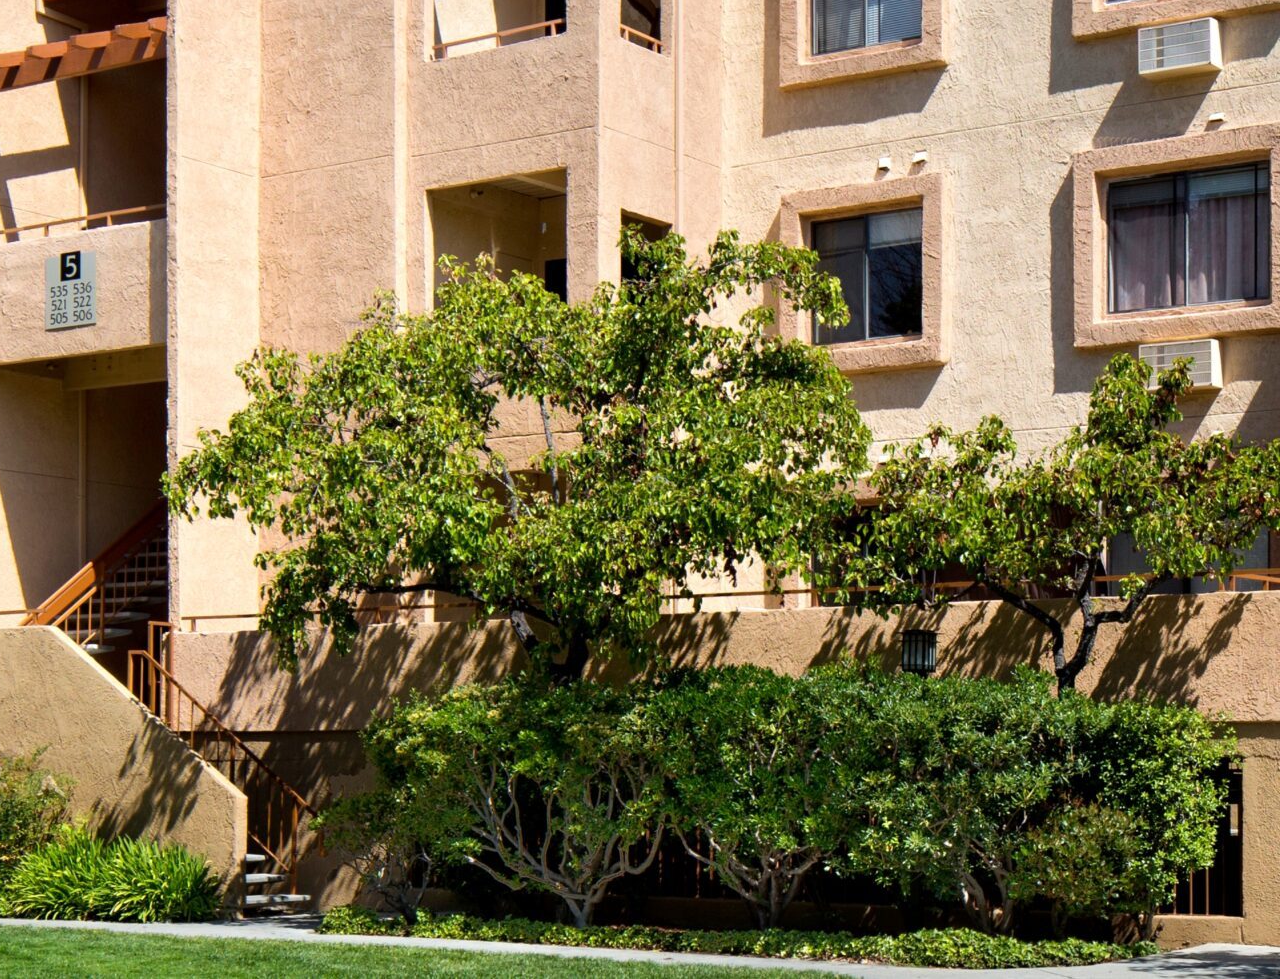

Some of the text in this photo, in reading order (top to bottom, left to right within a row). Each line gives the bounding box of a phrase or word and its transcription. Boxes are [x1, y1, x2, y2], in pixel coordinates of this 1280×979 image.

[65, 255, 77, 278] 5
[50, 282, 92, 298] 535 536
[51, 295, 92, 311] 521 522
[50, 309, 92, 325] 505 506
